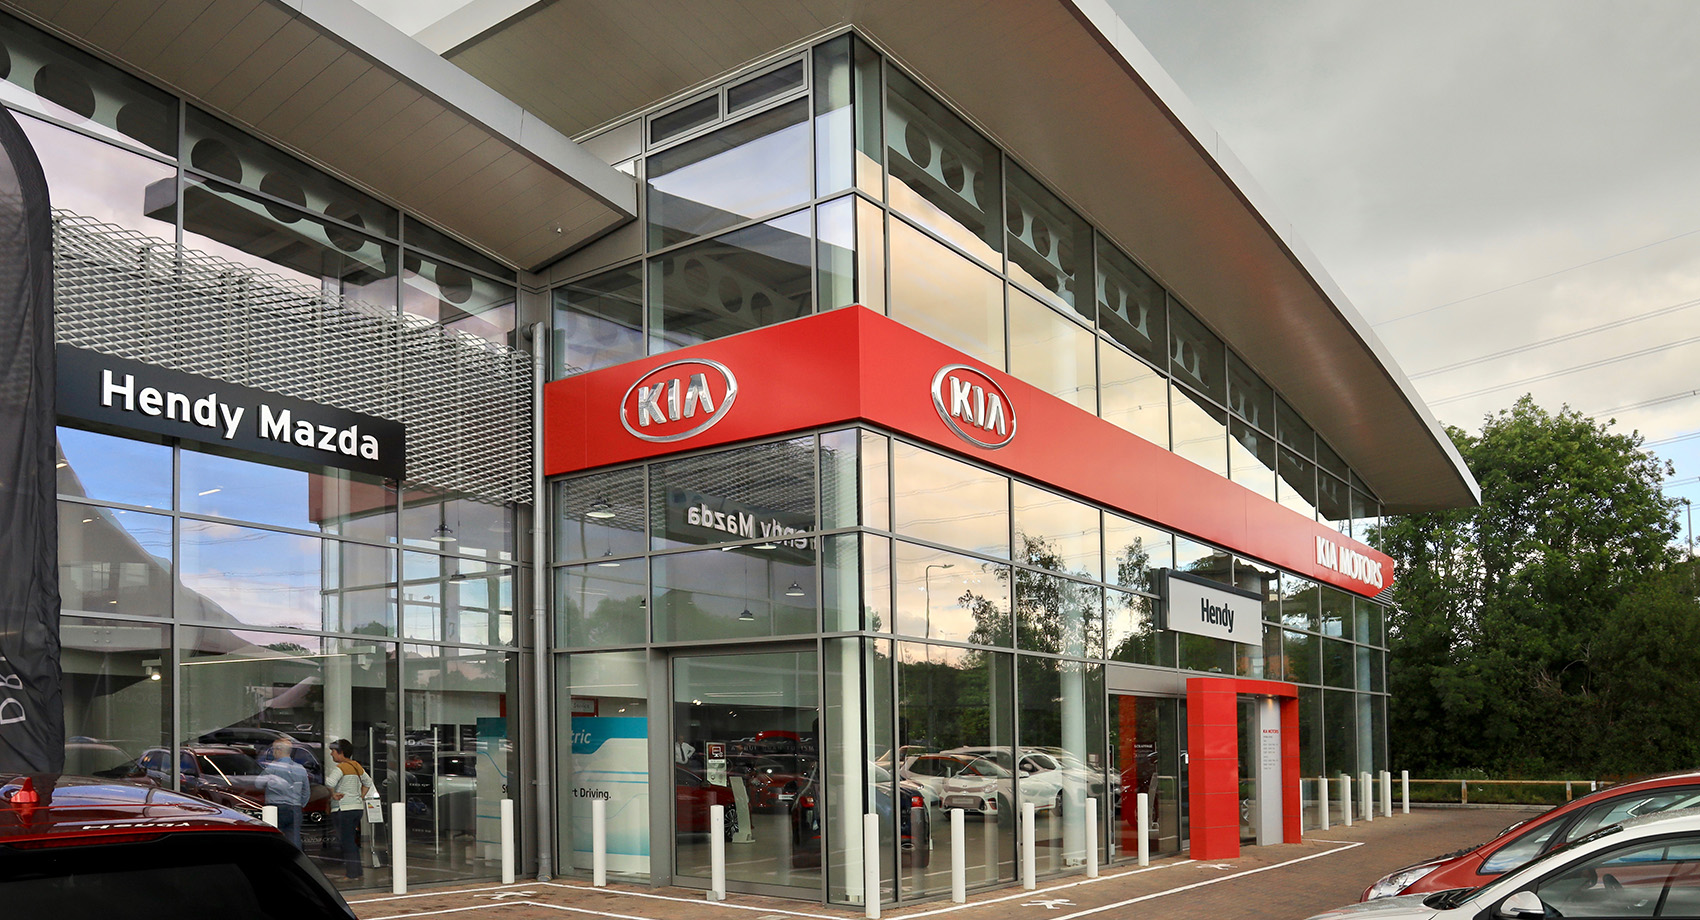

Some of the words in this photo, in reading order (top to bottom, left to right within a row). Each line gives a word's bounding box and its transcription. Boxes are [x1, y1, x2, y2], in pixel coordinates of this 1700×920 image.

[100, 369, 245, 440] Hendy
[258, 404, 380, 461] Mazda
[637, 373, 716, 428] KIA
[949, 375, 1007, 437] KIA
[1315, 535, 1339, 572] KIA
[1338, 546, 1384, 590] MOTORS
[1200, 597, 1235, 634] Hendy
[580, 788, 611, 801] Driving.
